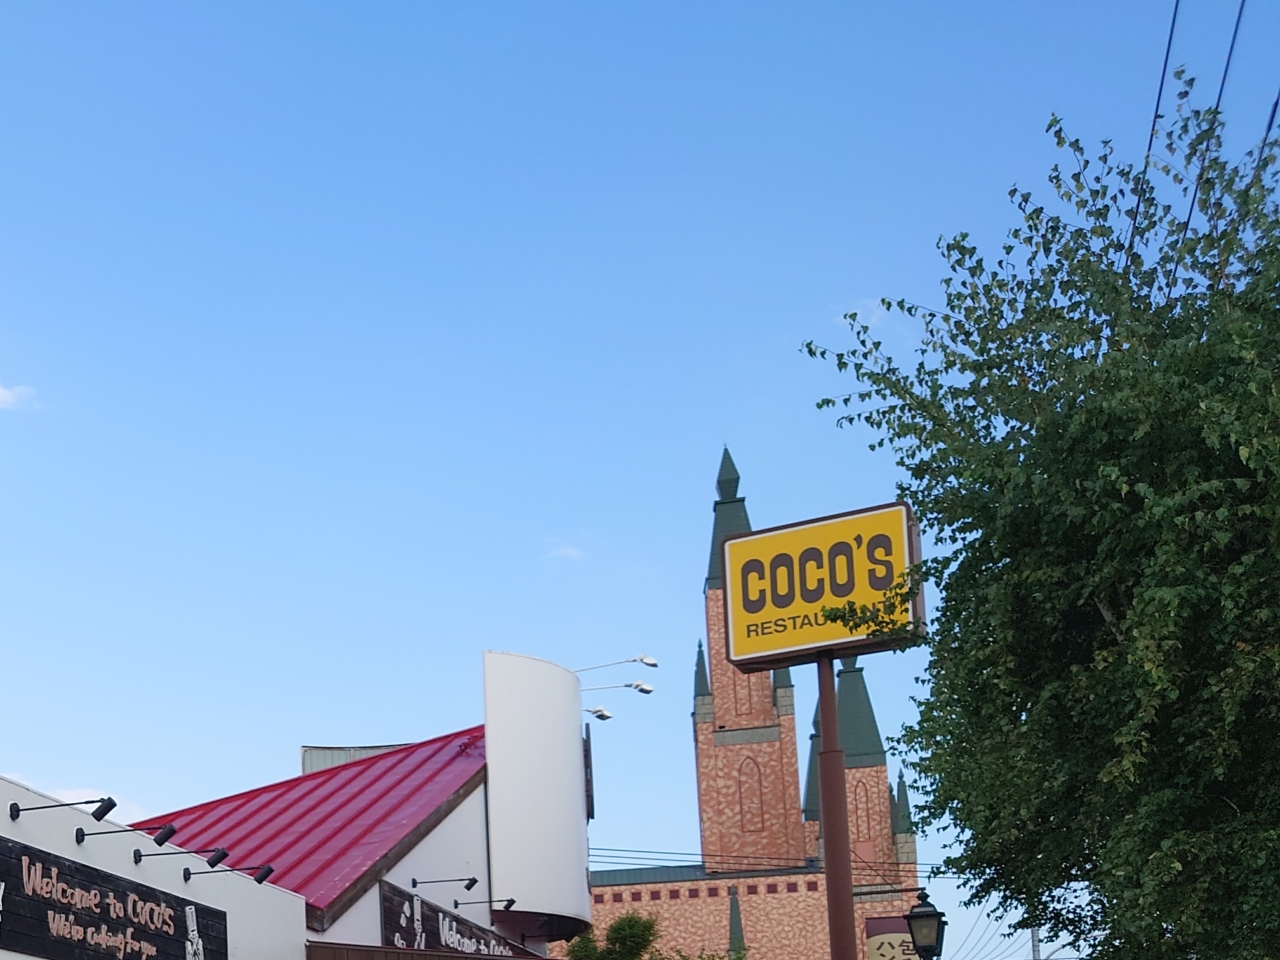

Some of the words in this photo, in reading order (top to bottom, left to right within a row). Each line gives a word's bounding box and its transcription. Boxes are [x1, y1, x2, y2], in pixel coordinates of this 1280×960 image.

[740, 533, 895, 615] COCO'S
[746, 600, 891, 639] RESTAU
[21, 855, 101, 914] Welcome
[105, 892, 125, 919] to
[47, 909, 85, 941] We're
[438, 912, 477, 954] Welcome
